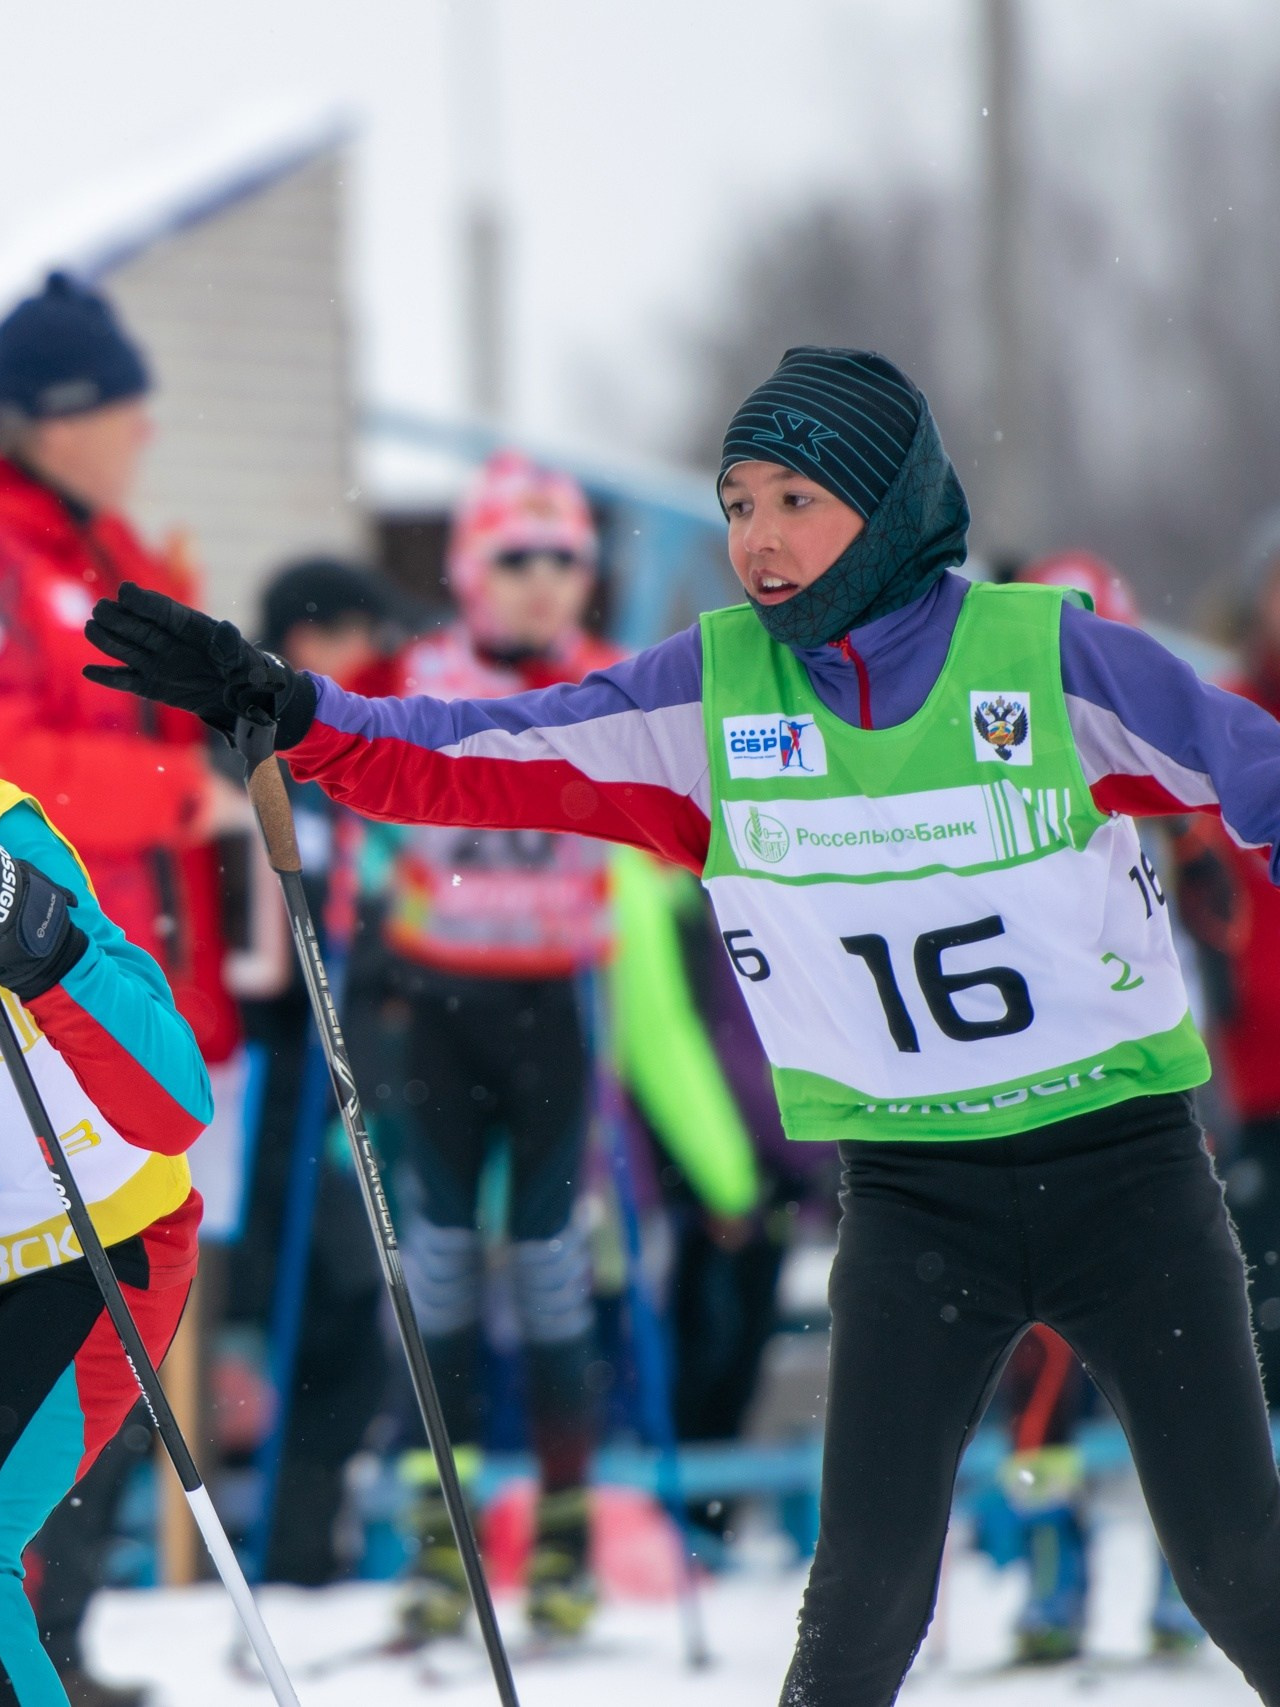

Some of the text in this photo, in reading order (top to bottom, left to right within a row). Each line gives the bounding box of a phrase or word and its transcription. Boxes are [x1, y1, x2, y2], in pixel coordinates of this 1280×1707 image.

[731, 737, 777, 752] СБР
[839, 914, 1035, 1054] 16
[1101, 952, 1144, 991] 2
